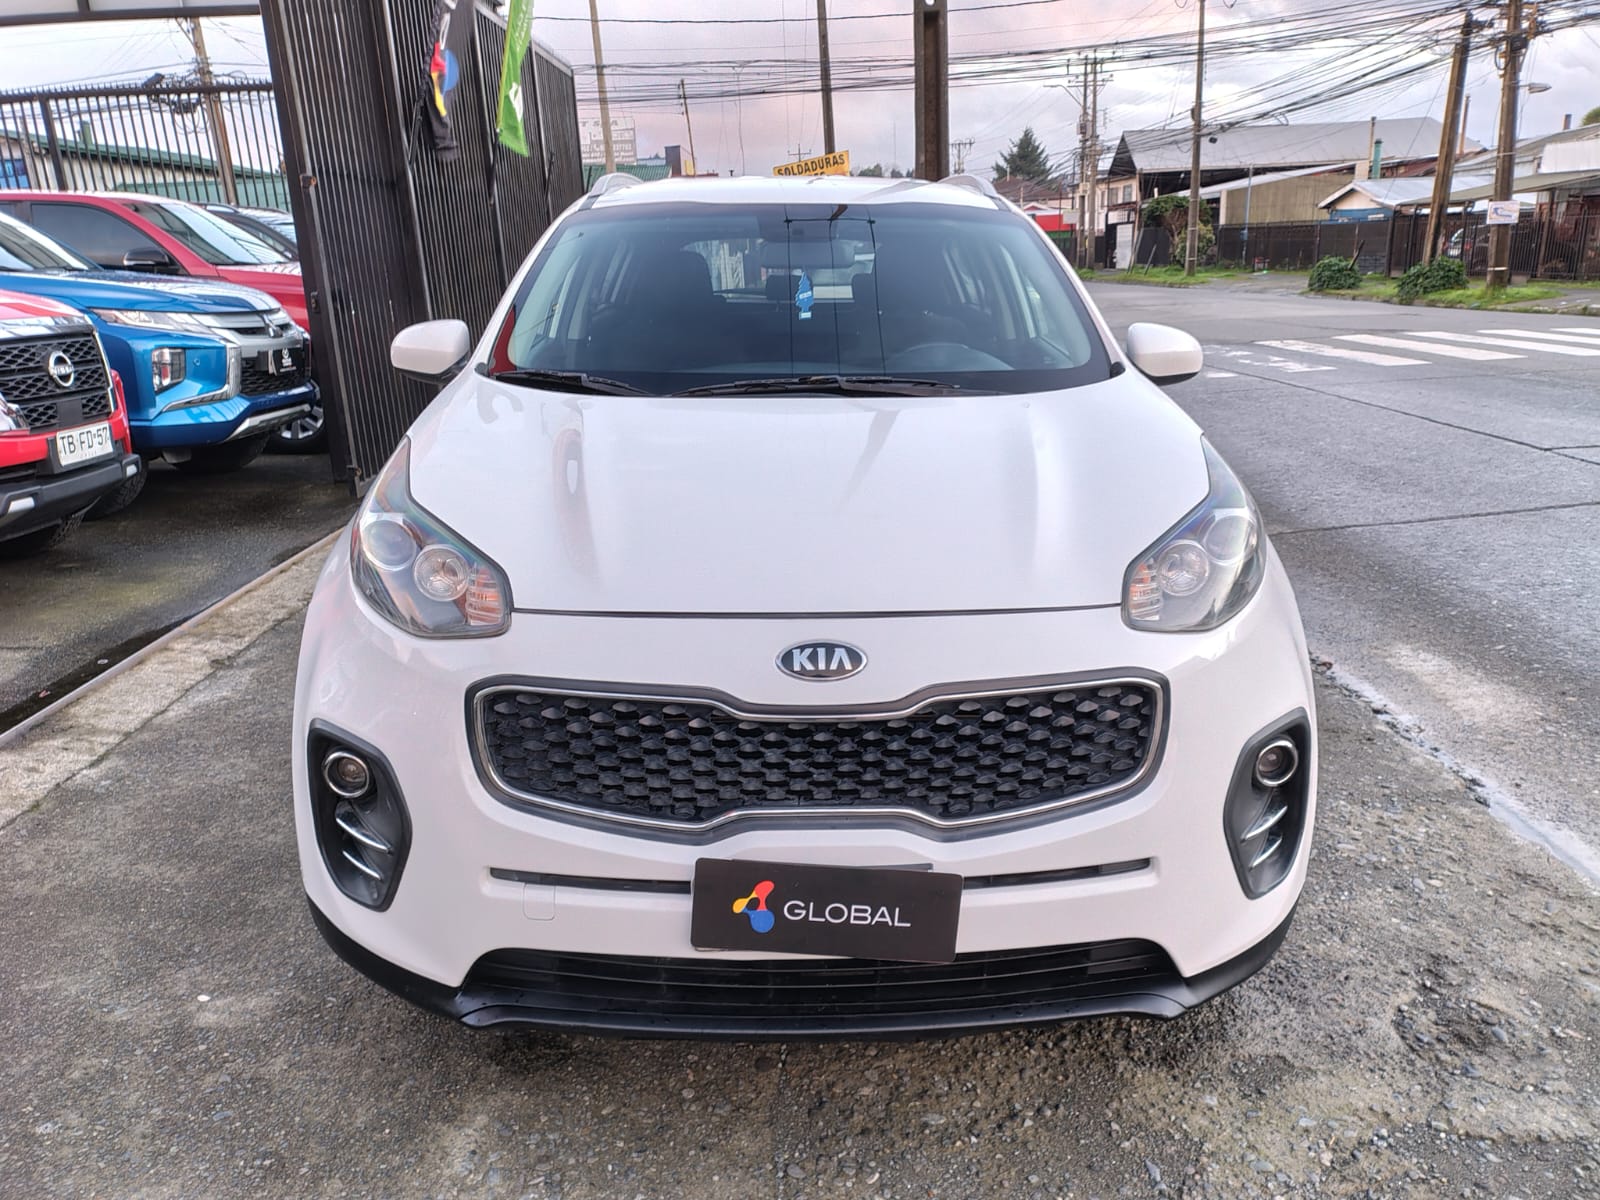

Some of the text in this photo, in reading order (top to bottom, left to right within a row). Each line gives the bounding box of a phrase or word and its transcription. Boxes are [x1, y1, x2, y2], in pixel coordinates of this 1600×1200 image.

[777, 154, 846, 176] SOLDADURAS
[792, 647, 853, 672] KIA
[783, 900, 912, 928] GLOBAL
